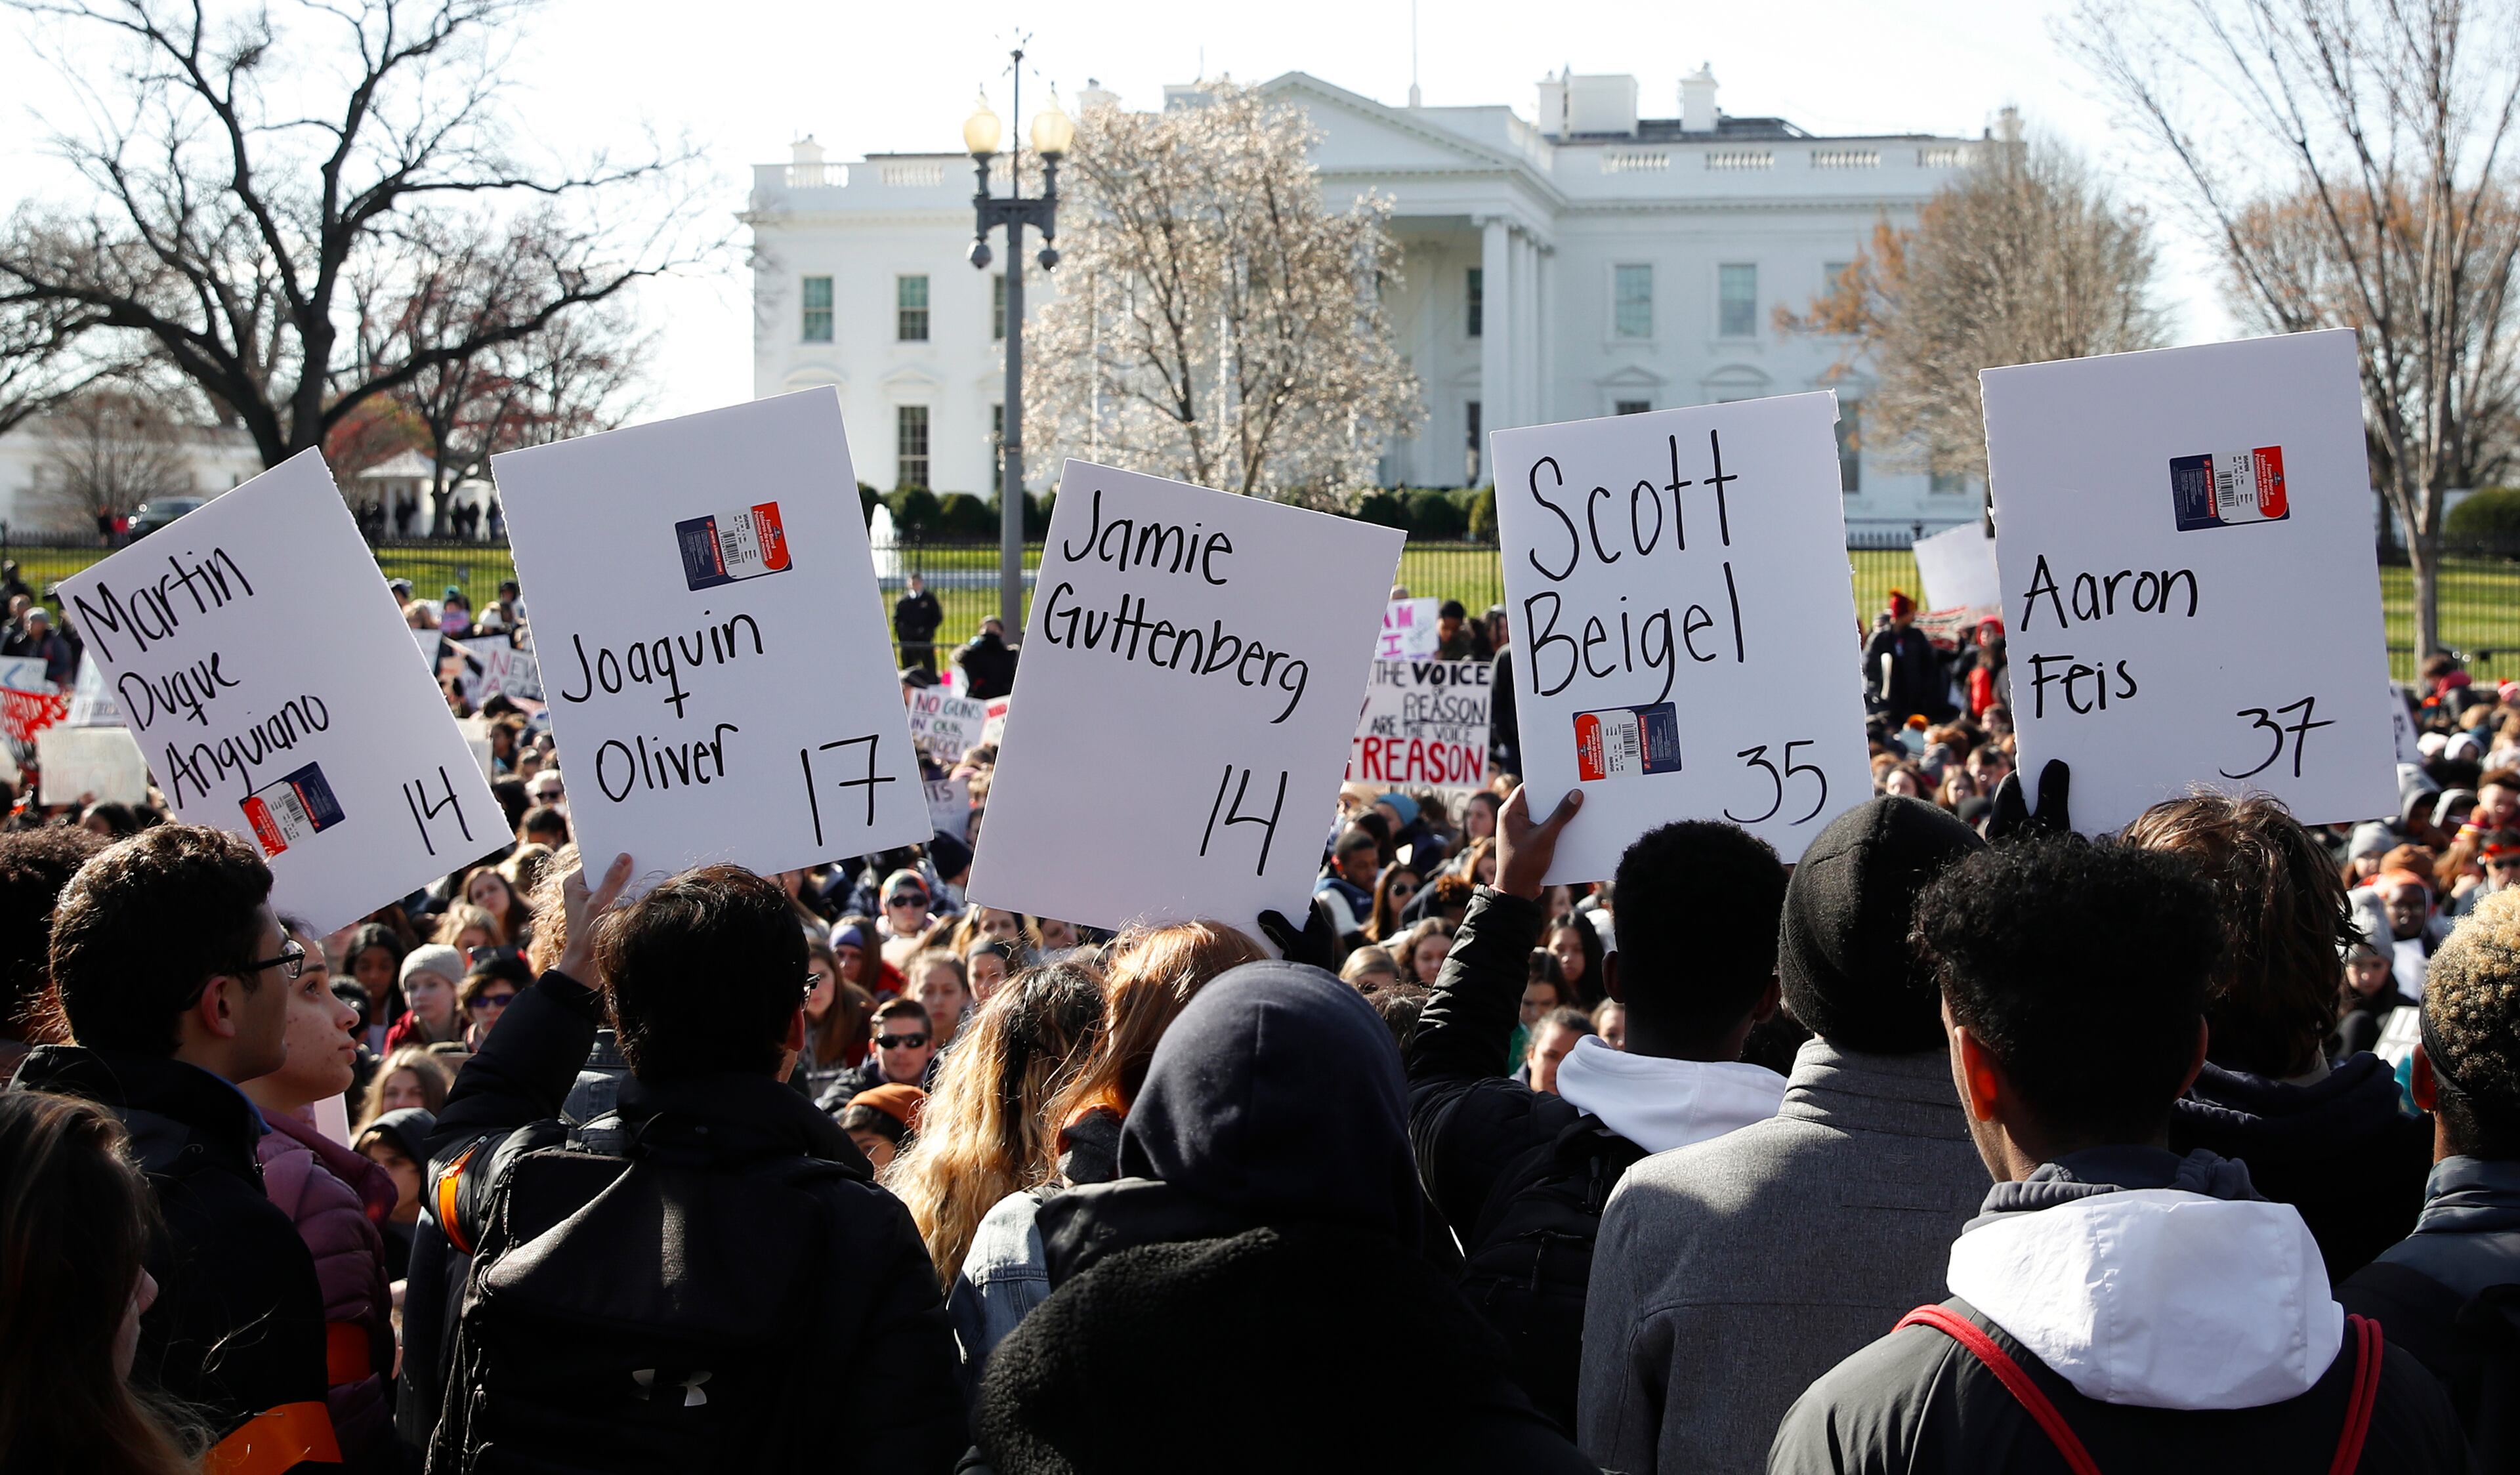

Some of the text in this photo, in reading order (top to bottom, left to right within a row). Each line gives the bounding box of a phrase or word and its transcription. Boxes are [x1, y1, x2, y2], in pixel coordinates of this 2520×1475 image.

[1064, 490, 1233, 585] Jamie
[1530, 430, 1738, 581] Scott
[74, 548, 254, 663] Martin
[1524, 562, 1744, 707] Beigel
[2021, 554, 2198, 631] Aaron
[117, 652, 240, 732] Duque
[562, 612, 764, 719] Joaquin
[1045, 583, 1309, 724] Guttenberg
[1374, 661, 1490, 686] THE VOICE
[2028, 654, 2137, 719] Feis
[916, 693, 940, 713] NO
[944, 697, 982, 720] GUNS
[1370, 715, 1475, 743] ARE THE VOICE
[1402, 692, 1486, 724] REASON
[2220, 697, 2335, 779] 37
[166, 695, 329, 810] Anguiano
[596, 724, 739, 802] Oliver
[801, 734, 896, 847] 17
[1724, 740, 1827, 825] 35
[403, 766, 473, 856] 14
[1200, 764, 1288, 877] 14
